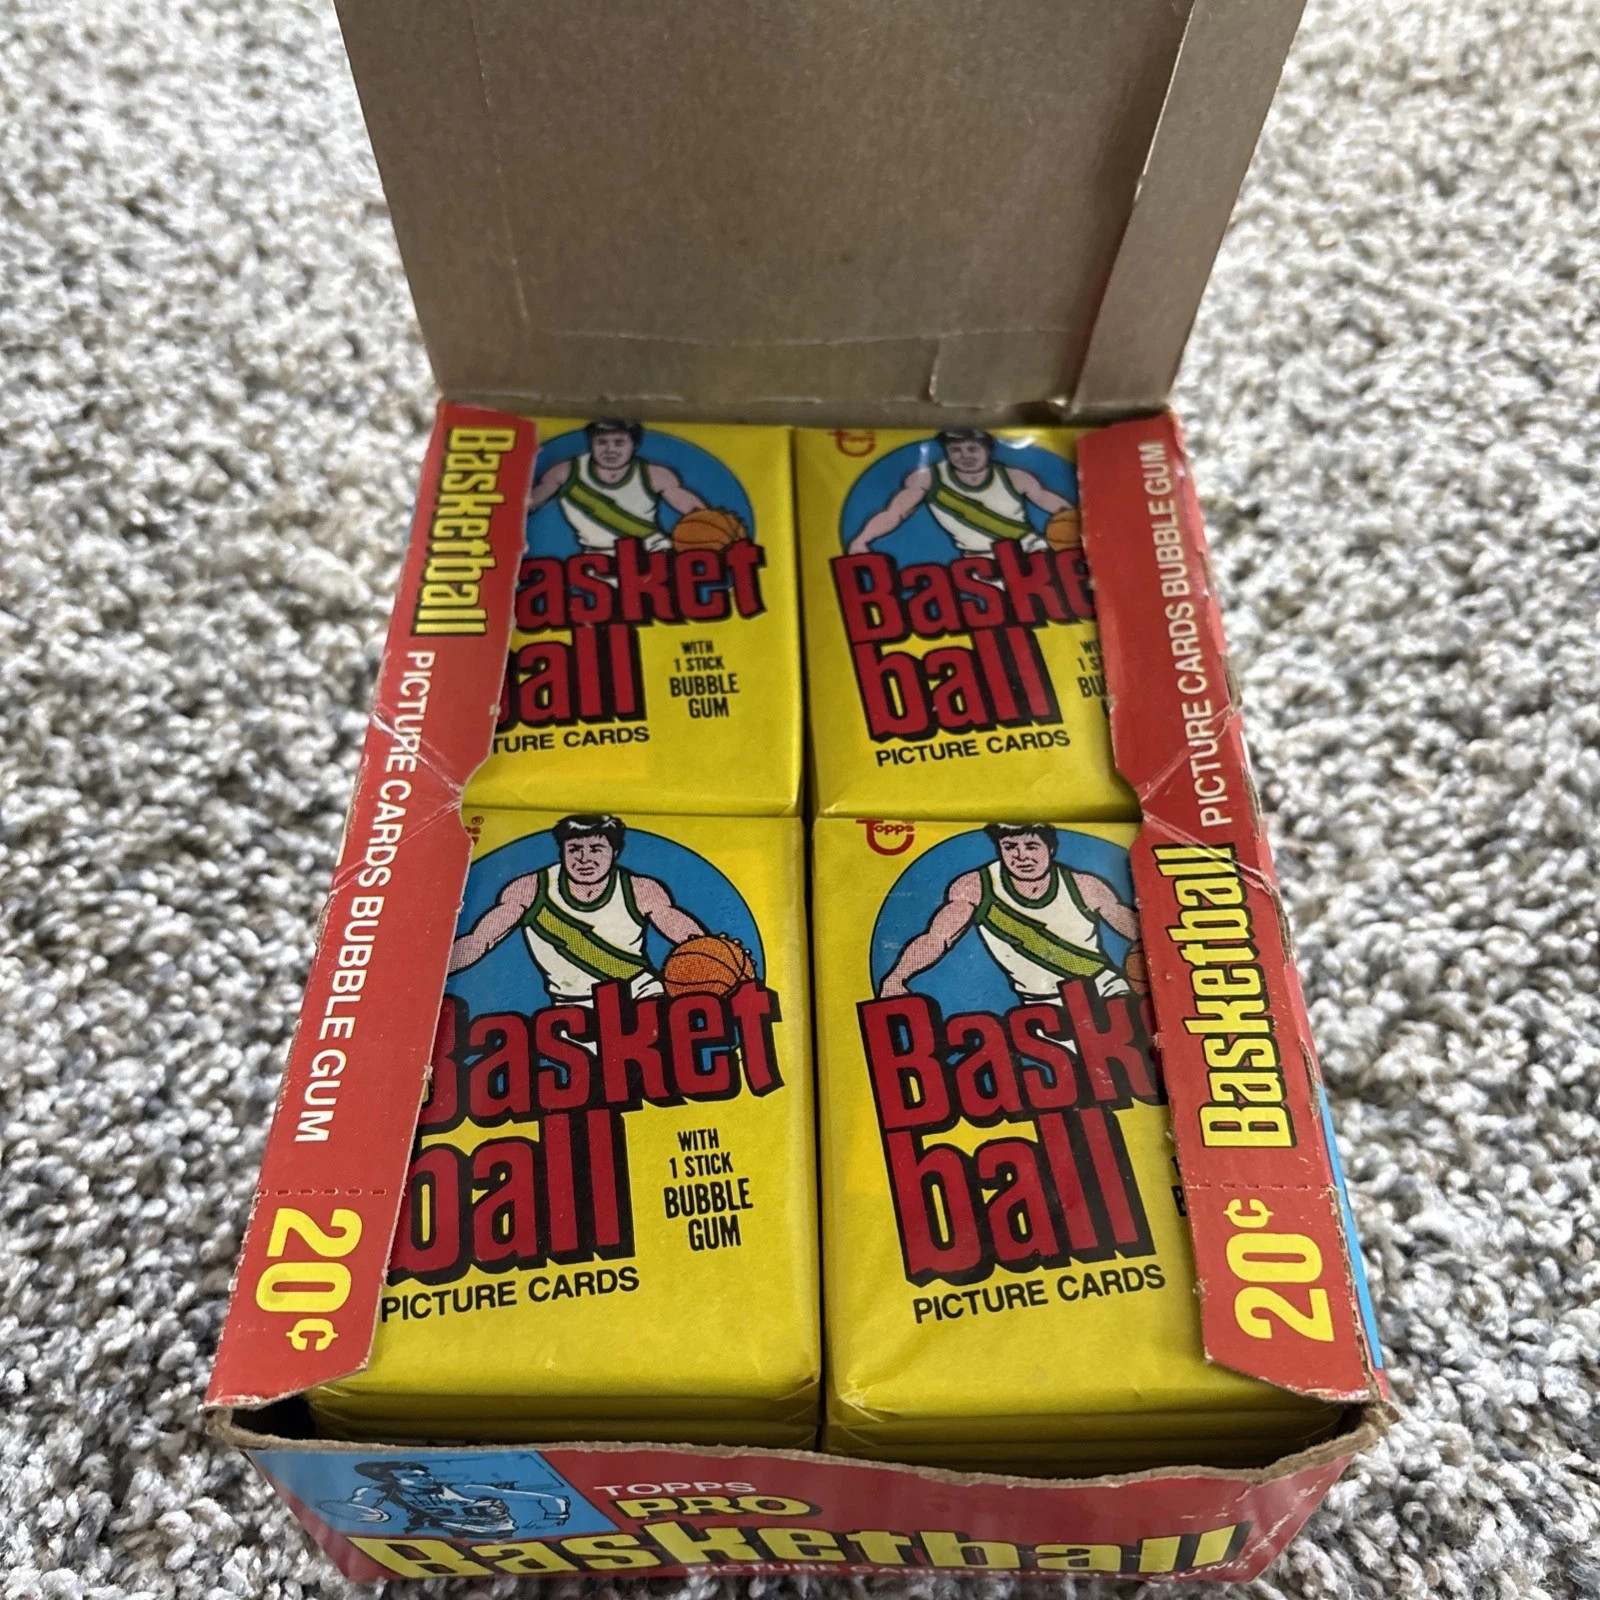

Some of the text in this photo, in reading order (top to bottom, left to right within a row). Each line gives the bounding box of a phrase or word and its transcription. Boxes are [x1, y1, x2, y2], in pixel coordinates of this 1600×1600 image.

[1138, 442, 1173, 496] GUM
[1148, 500, 1191, 597] BUBBLE
[514, 536, 767, 633] asket
[829, 539, 1097, 646] Baske
[674, 656, 726, 673] 1 STICK
[681, 640, 715, 656] WITH
[1164, 601, 1208, 695] CARDS
[669, 674, 740, 698] BUBBLE
[688, 697, 730, 719] GUM
[852, 625, 1064, 743] ball
[493, 726, 650, 754] TURE CARDS
[875, 730, 1071, 767] PICTURE CARDS
[1181, 699, 1233, 828] PICTURE
[294, 428, 517, 1142] Basketball PICTURE CARDS BUBBLE GUM
[855, 818, 915, 856] Topps
[1152, 842, 1298, 1149] Basketball
[856, 978, 1166, 1134] Bask
[668, 1153, 734, 1179] 1 STICK
[677, 1128, 720, 1152] WITH
[663, 1178, 754, 1219] BUBBLE
[882, 1106, 1157, 1289] ball
[688, 1213, 742, 1252] GUM
[381, 1266, 640, 1323] PICTURE CARDS
[912, 1264, 1166, 1324] PICTURE CARDS
[593, 1481, 757, 1496] TOPPS
[611, 1494, 823, 1521] PRO
[346, 1520, 1255, 1580] Basketball
